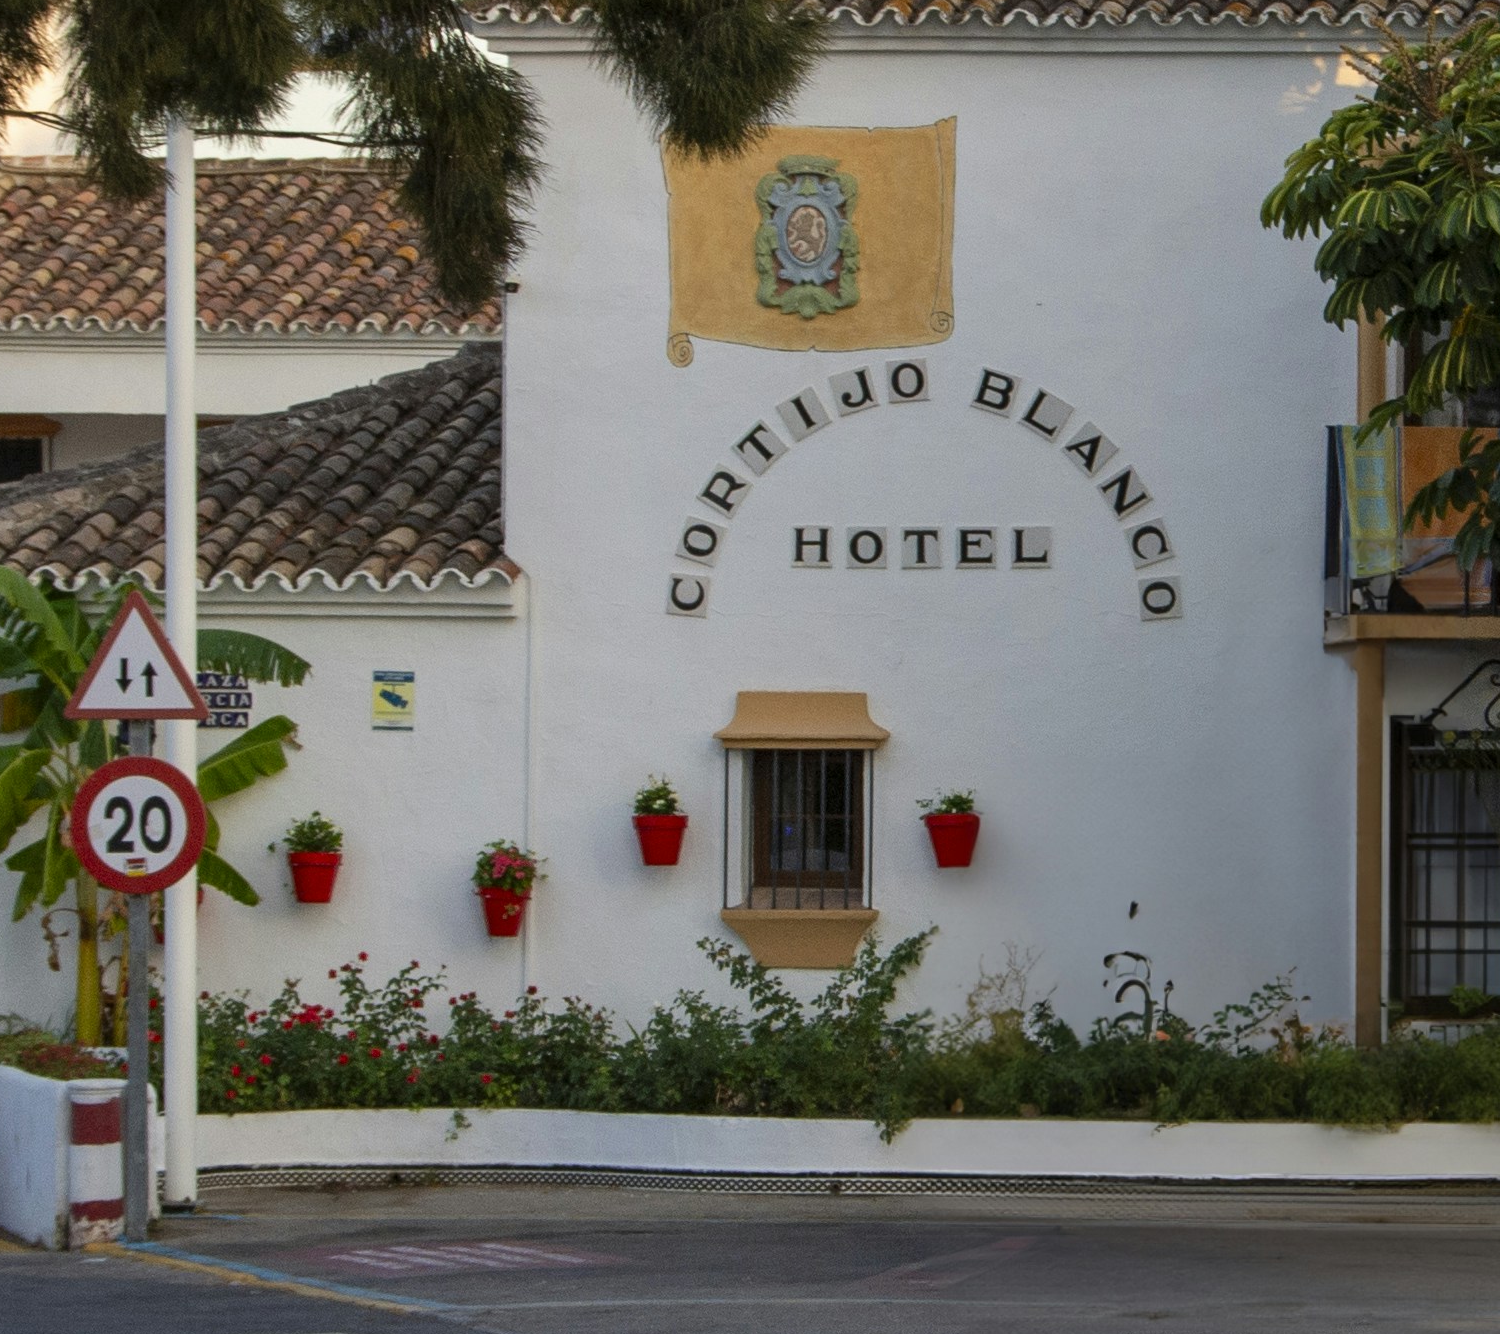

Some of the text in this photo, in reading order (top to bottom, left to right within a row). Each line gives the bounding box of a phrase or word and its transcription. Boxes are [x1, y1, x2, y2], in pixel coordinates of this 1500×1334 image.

[670, 362, 1177, 615] CORTIJO BLANCO
[793, 526, 1048, 565] HOTEL
[202, 693, 250, 707] RCIA
[205, 713, 247, 726] RCA
[103, 795, 172, 854] 20
